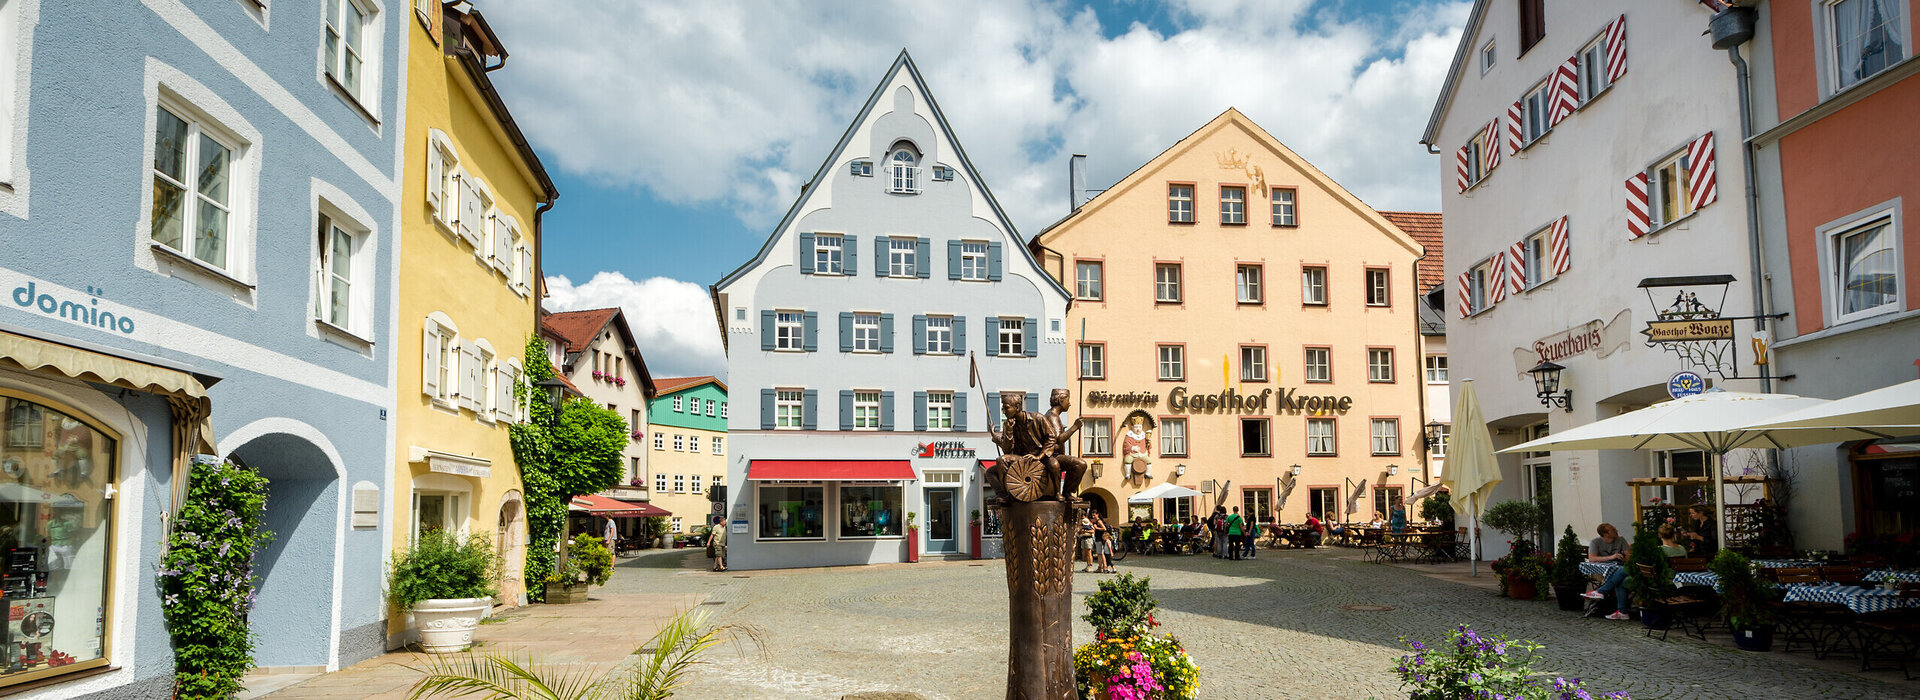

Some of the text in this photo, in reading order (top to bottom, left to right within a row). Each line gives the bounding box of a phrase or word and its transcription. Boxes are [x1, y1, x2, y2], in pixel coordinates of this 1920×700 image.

[1652, 322, 1730, 338] Gasthof Woaze
[1535, 328, 1602, 365] Feuerhaus
[1088, 390, 1160, 403] Bärenbräu
[1169, 386, 1353, 411] Gasthof Krone
[934, 440, 965, 449] OPTIK
